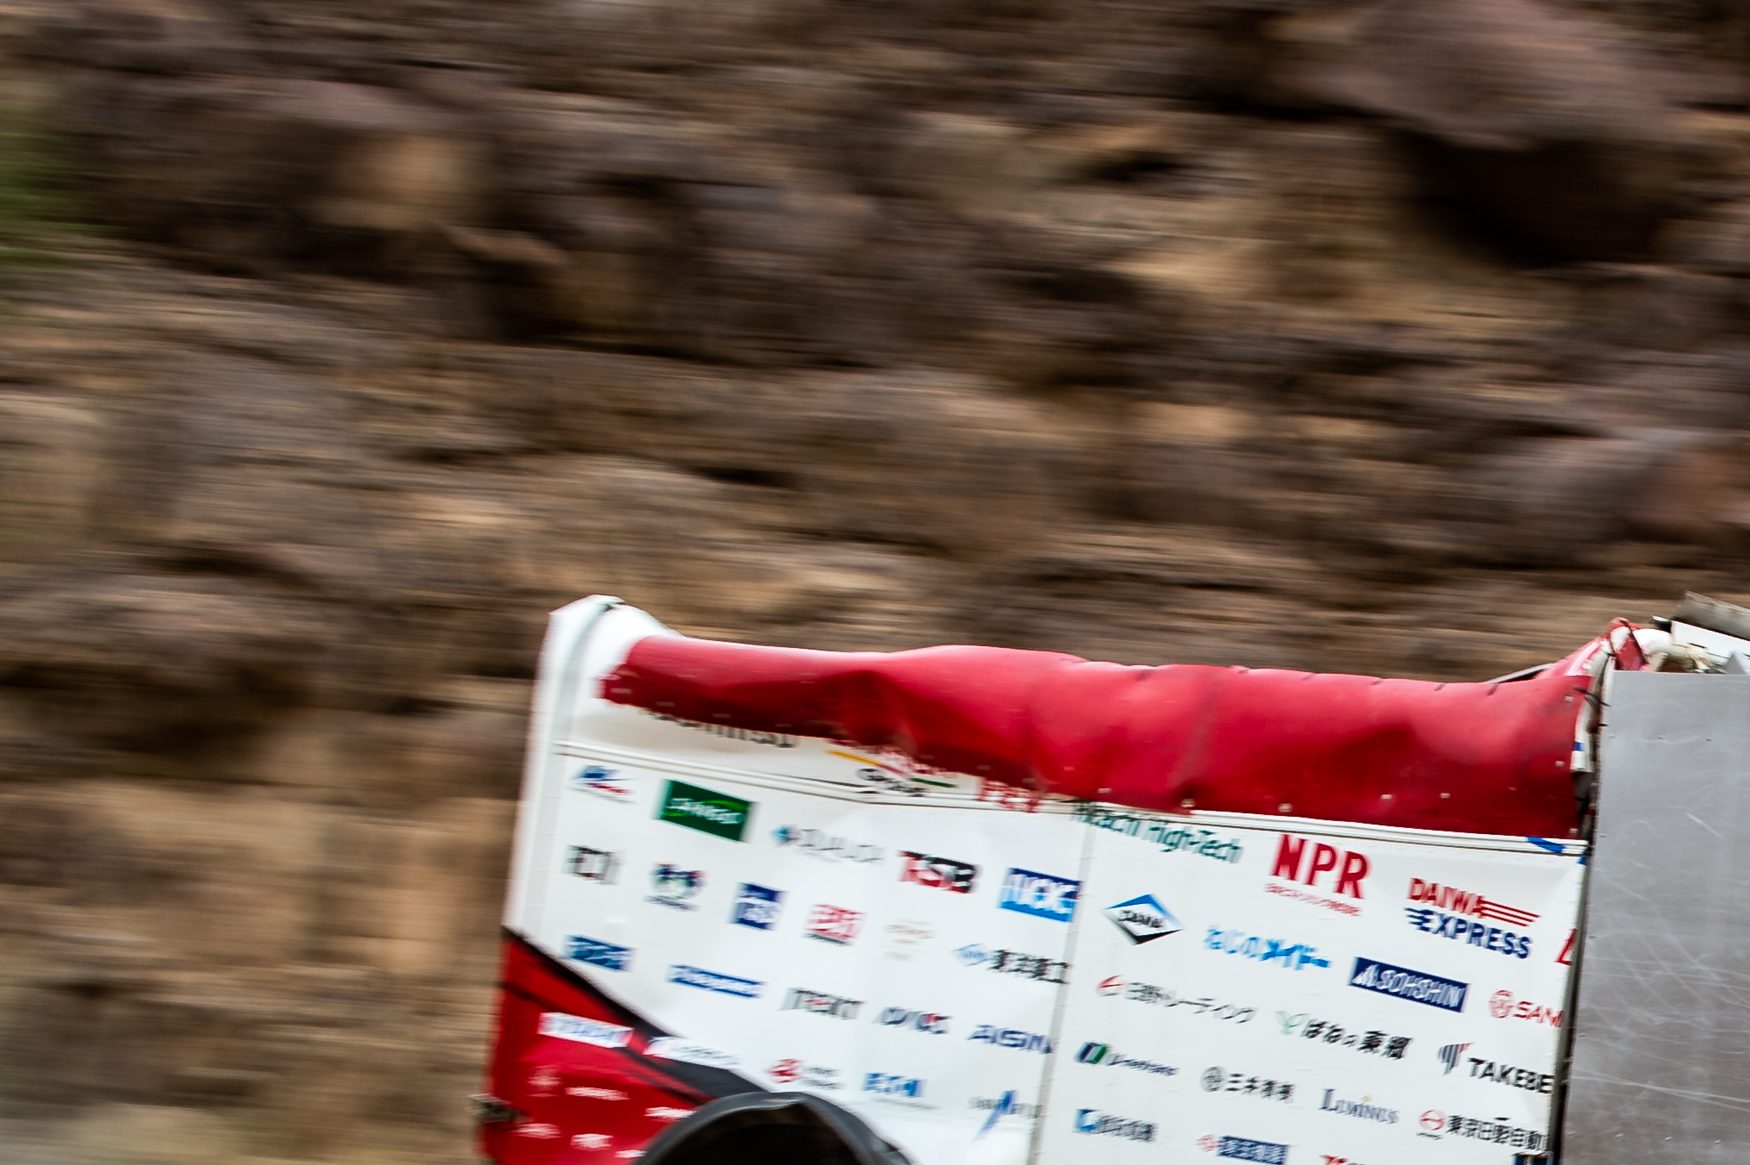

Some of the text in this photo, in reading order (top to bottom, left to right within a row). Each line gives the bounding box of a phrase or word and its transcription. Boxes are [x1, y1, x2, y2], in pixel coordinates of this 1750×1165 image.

[1269, 833, 1371, 899] NPR
[1407, 877, 1484, 919] DAIWA
[1203, 925, 1332, 971] ねじのメイドー
[1404, 907, 1533, 960] EXPRESS
[1376, 968, 1465, 1010] SOHSHIN
